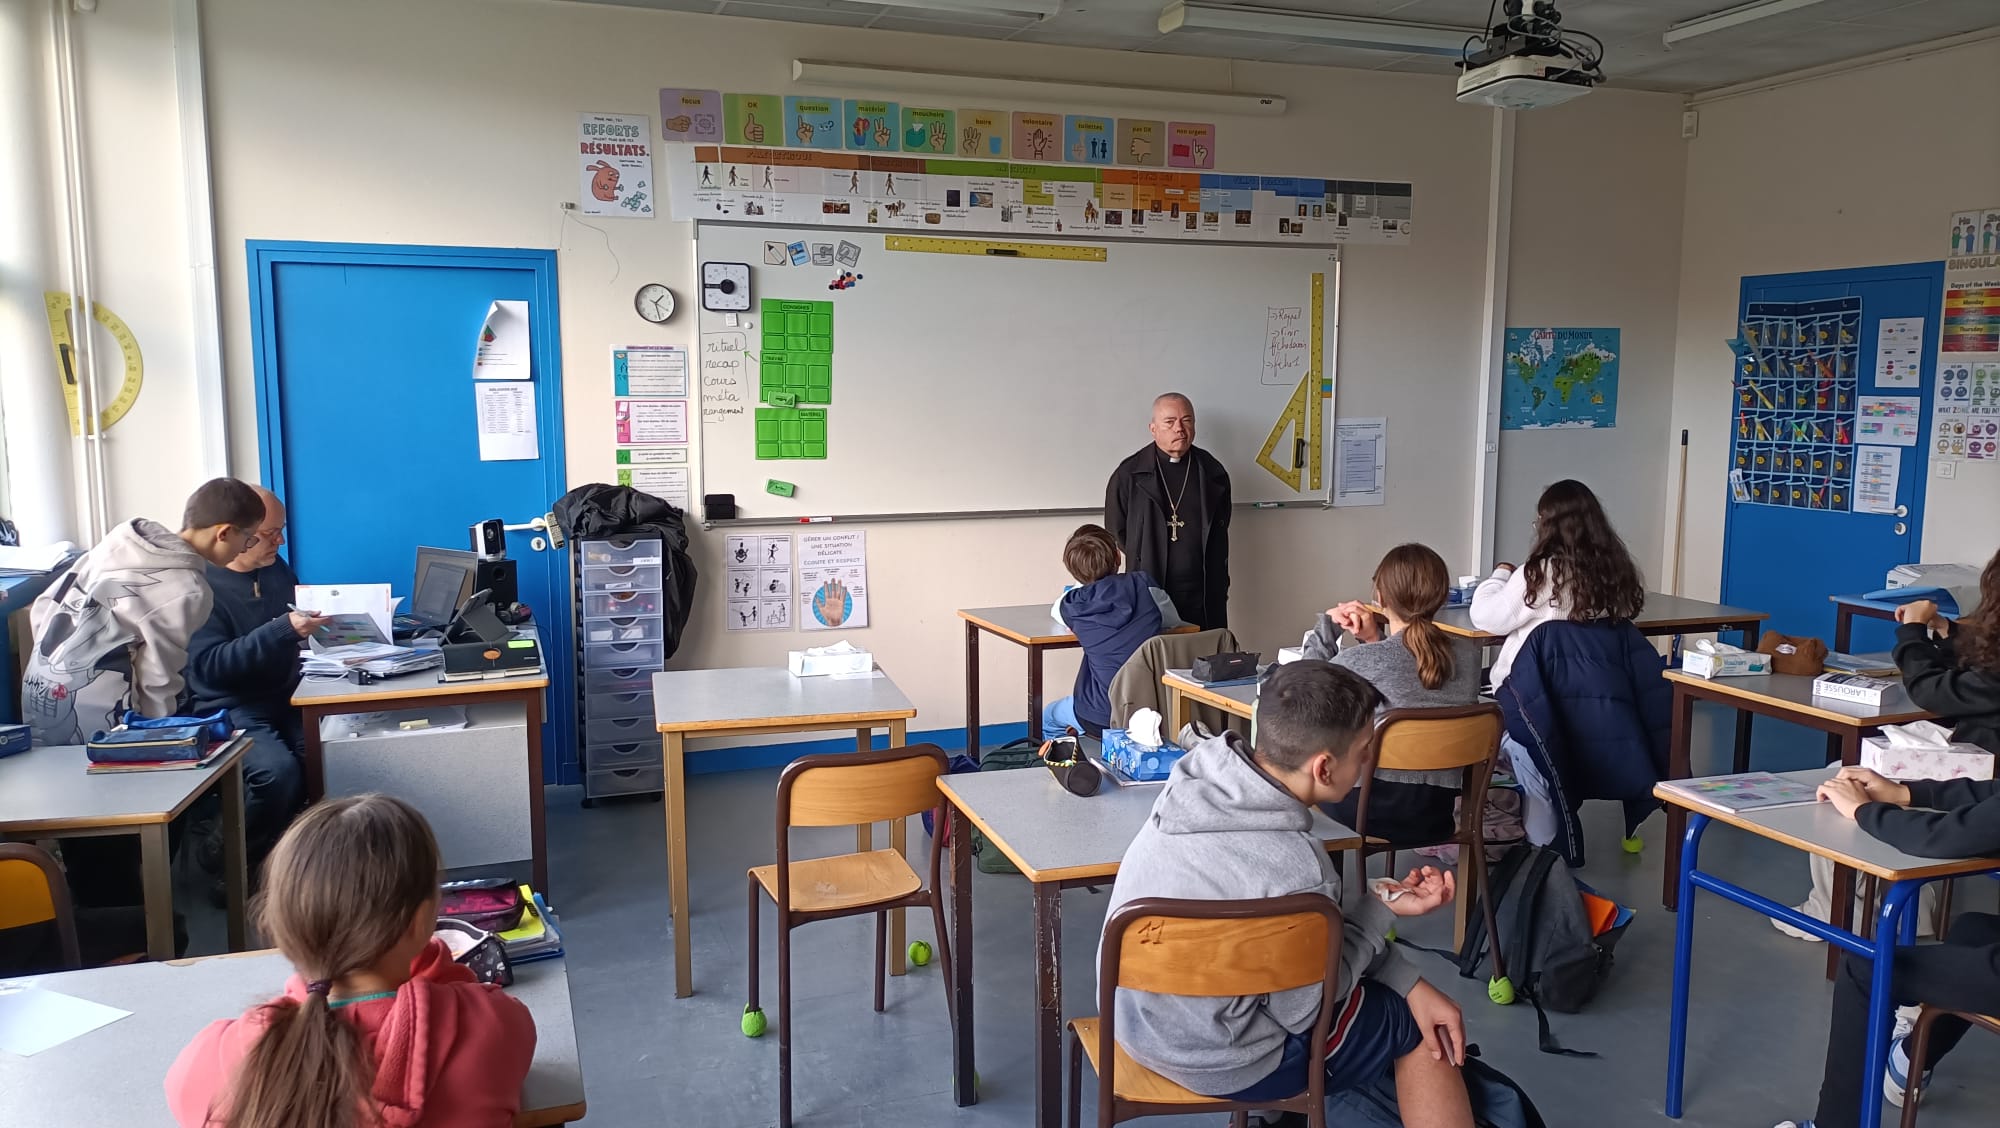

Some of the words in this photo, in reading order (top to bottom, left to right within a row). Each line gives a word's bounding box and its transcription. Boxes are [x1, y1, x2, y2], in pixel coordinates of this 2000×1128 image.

[681, 96, 701, 105] focus
[912, 111, 945, 119] mouchoirs
[1022, 118, 1053, 126] volontaire
[583, 123, 640, 138] EFFORTS
[580, 141, 650, 156] RÉSULTATS.
[1959, 326, 1984, 334] Thursday
[1557, 331, 1568, 341] DU
[706, 337, 746, 353] rituel
[702, 406, 745, 422] rangement
[817, 549, 843, 557] DÉLICATE
[836, 557, 860, 565] RESPECT
[1823, 682, 1867, 698] LAROUSSE
